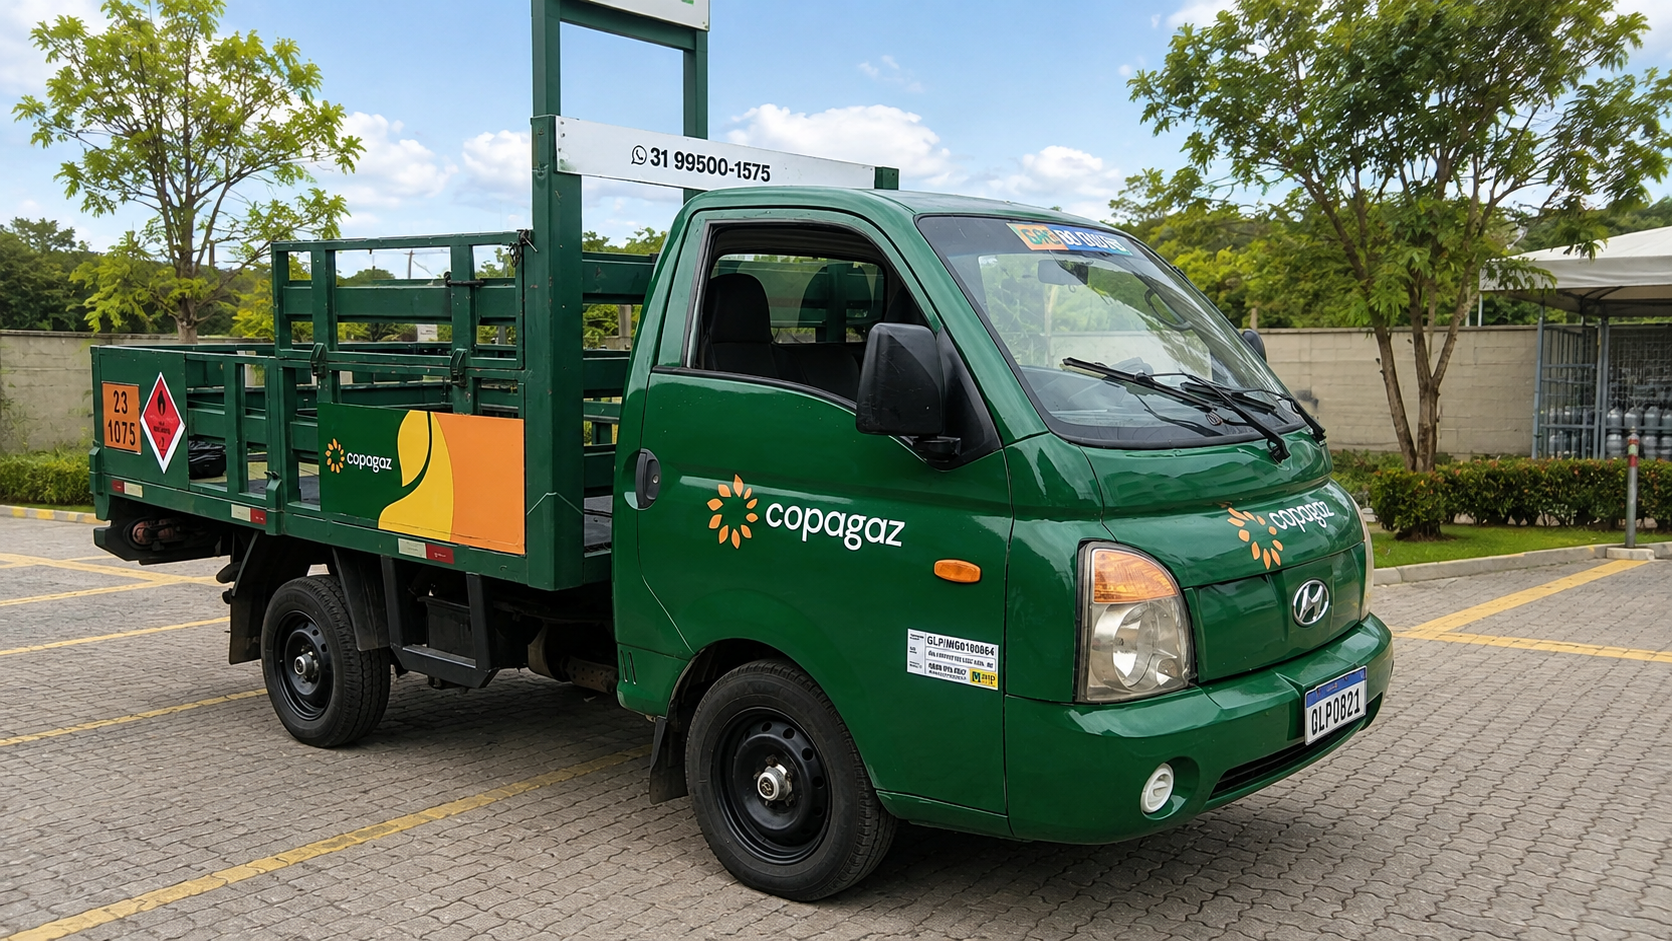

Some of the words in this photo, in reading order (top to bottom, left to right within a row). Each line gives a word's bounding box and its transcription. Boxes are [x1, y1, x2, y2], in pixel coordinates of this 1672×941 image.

[650, 147, 668, 168] 31
[674, 151, 771, 182] 99500-1575
[113, 390, 128, 414] 23
[108, 419, 136, 446] 1075
[346, 452, 392, 473] copagaz
[765, 503, 906, 551] copagaz
[1268, 501, 1335, 533] copagaz
[1311, 687, 1360, 736] GLP0821
